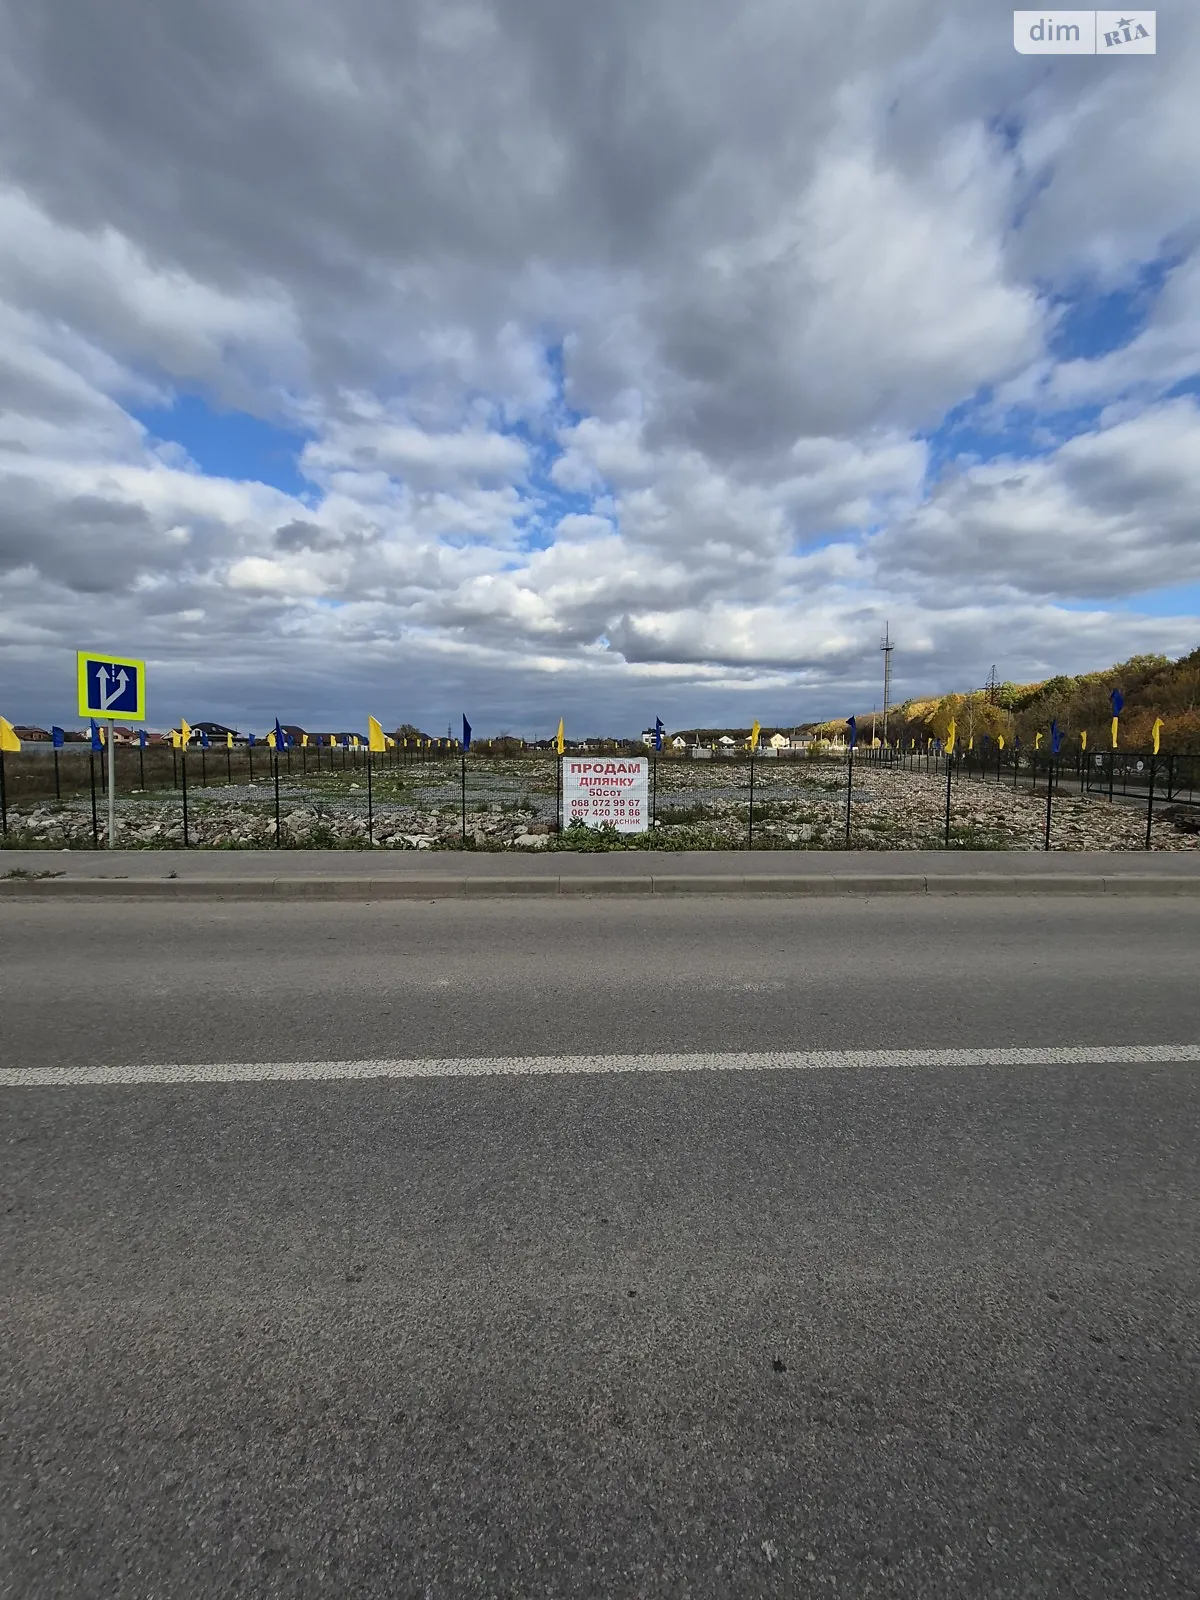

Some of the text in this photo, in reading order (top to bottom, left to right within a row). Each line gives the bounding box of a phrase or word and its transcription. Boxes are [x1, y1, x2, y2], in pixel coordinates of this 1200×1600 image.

[570, 763, 641, 775] ПРОДАМ
[579, 777, 634, 786] ДІЛЯНКУ
[589, 788, 622, 797] 50сот
[571, 799, 640, 807] 068 072 99 67
[571, 808, 641, 816] 067 420 38 86
